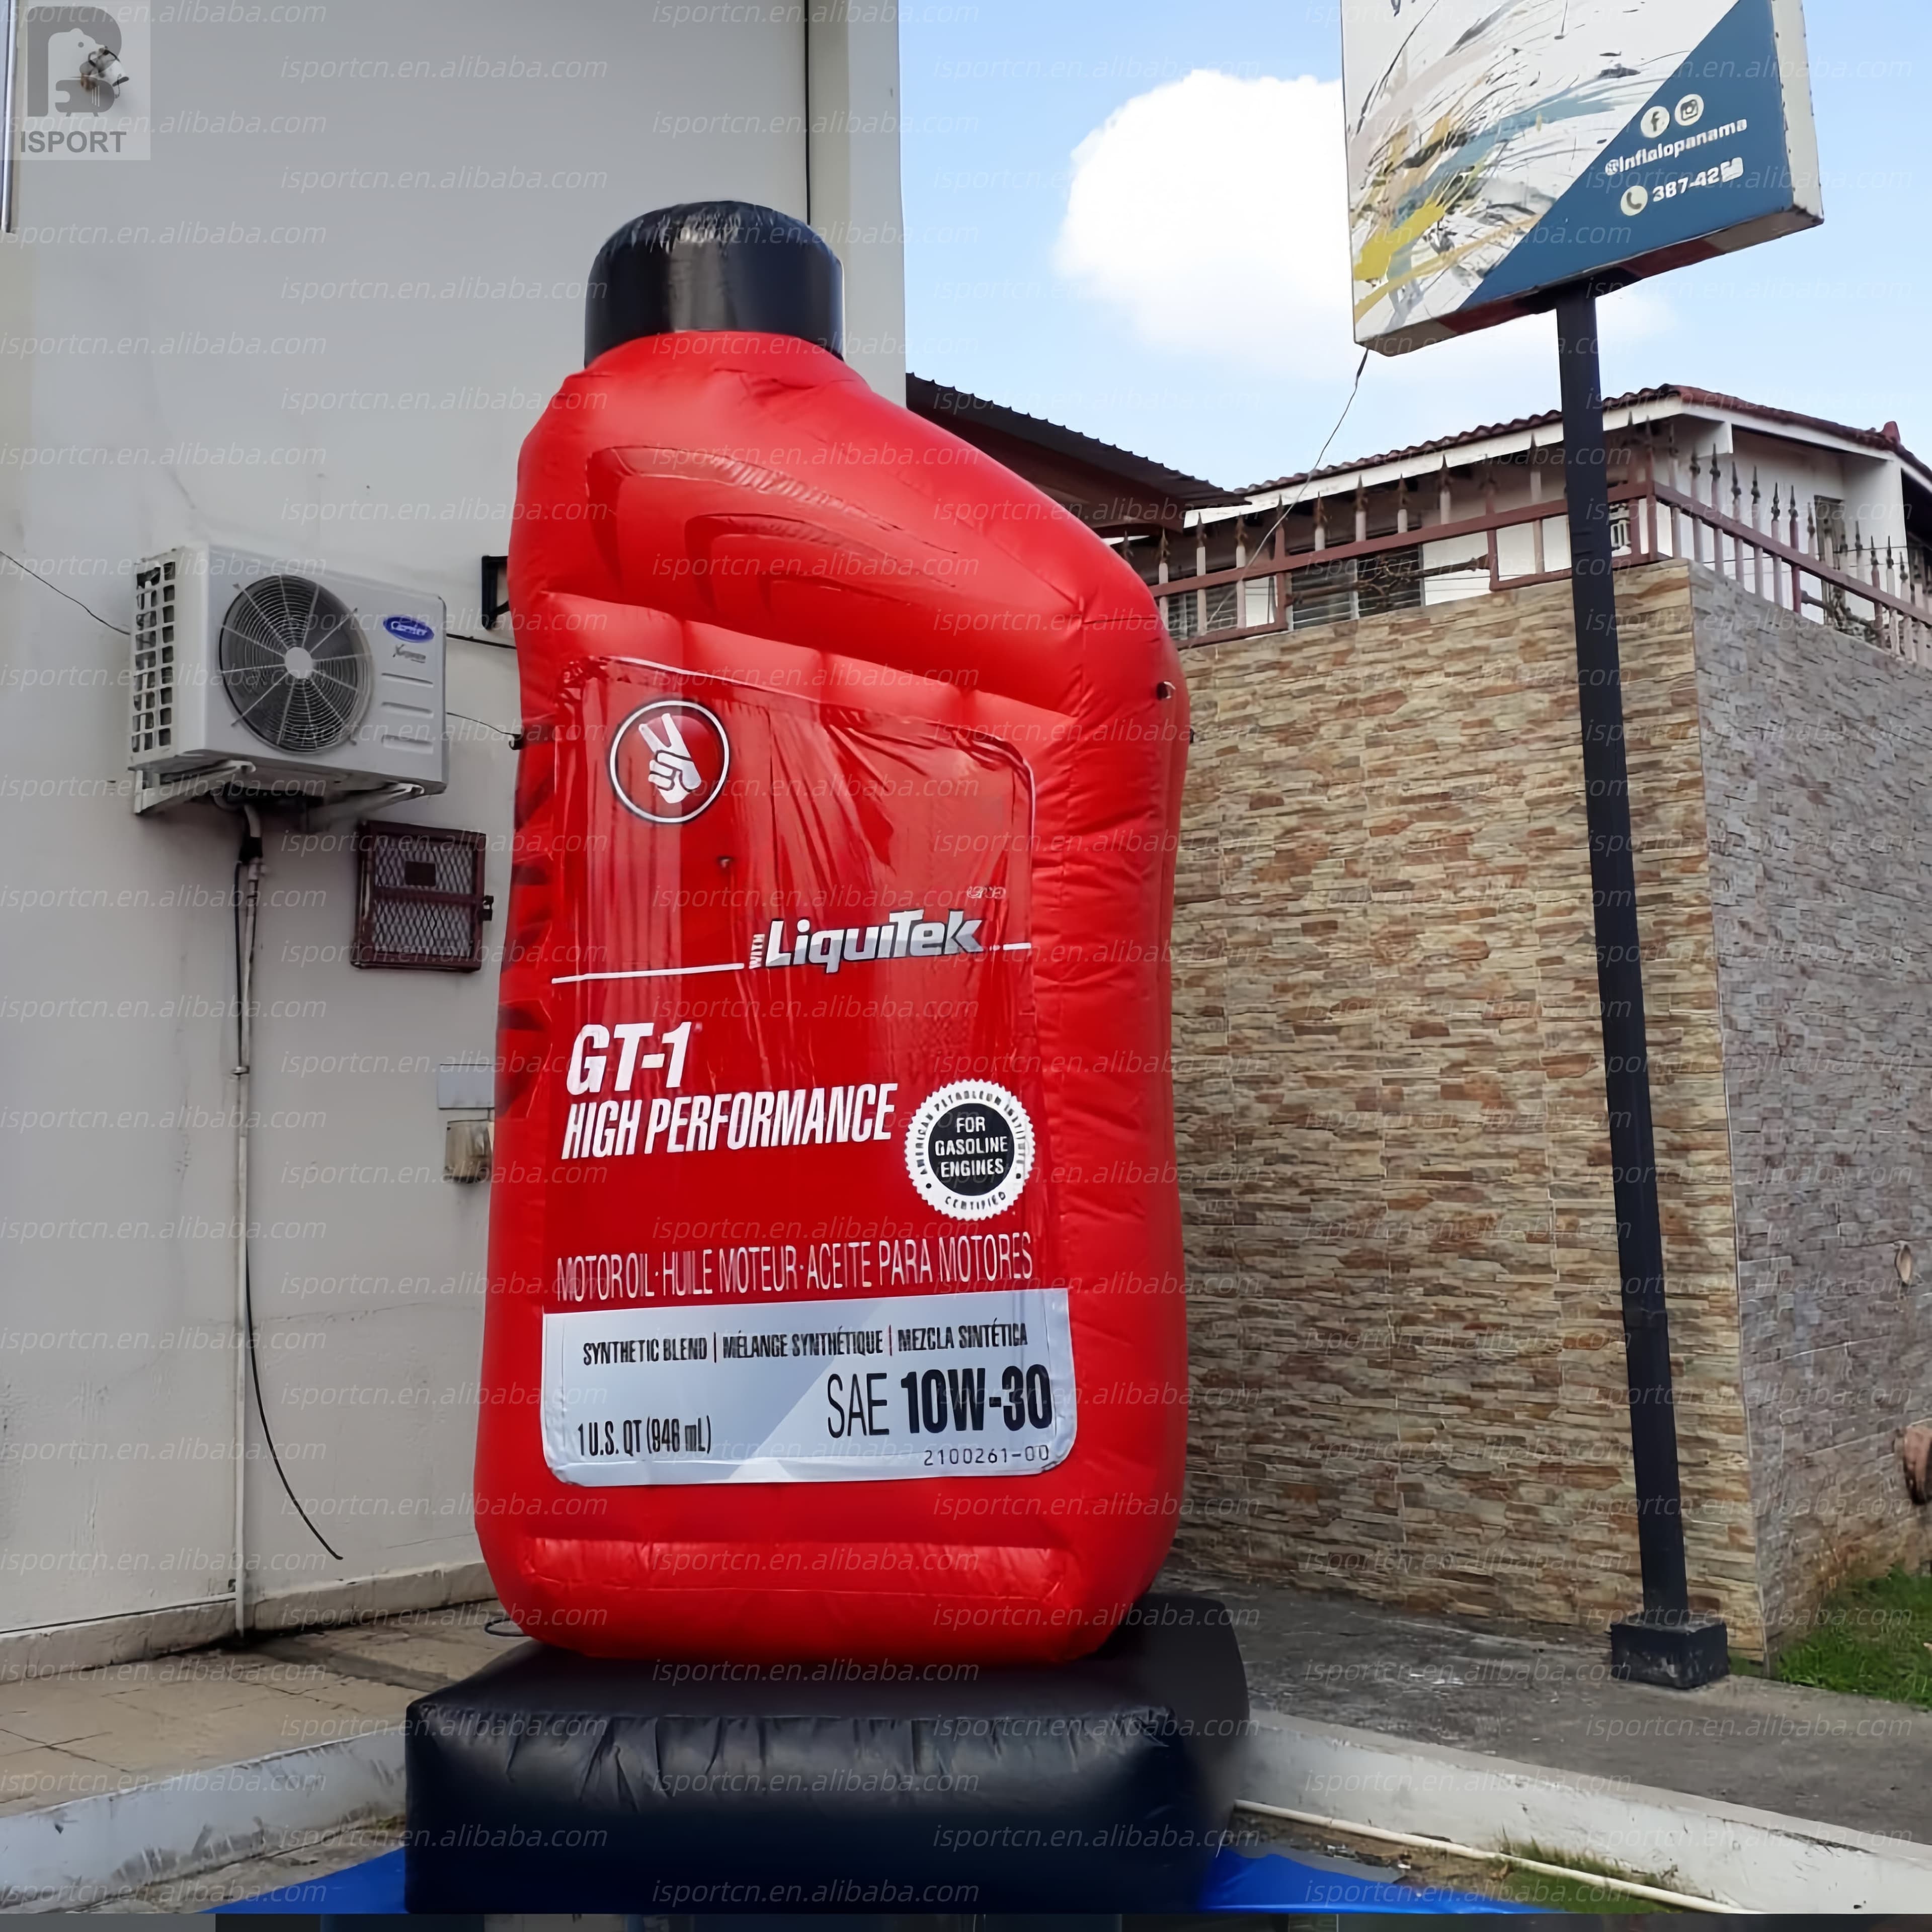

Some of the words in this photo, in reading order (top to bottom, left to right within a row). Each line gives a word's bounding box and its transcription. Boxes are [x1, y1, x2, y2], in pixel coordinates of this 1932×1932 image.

[765, 909, 984, 974] LiquiTek
[566, 1021, 692, 1095] GT-1
[561, 1100, 642, 1159] HIGH
[644, 1083, 898, 1154] PERFORMANCE
[956, 1116, 986, 1133] FOR
[935, 1136, 1008, 1156] GASOLINE
[941, 1158, 1004, 1177] ENGINES
[878, 1238, 933, 1286] PARA
[939, 1232, 1033, 1282] MOTORES
[583, 1338, 659, 1365] SYNTHETIC
[663, 1337, 707, 1361] BLEND
[722, 1330, 788, 1359] MÉLANGE
[791, 1325, 883, 1357] SYNTHÉTIQUE
[898, 1326, 954, 1352] MEZCLA
[827, 1373, 890, 1438] SAE
[900, 1364, 1053, 1434] 10W-30
[578, 1423, 585, 1456] 1
[589, 1420, 619, 1456] U.S.
[623, 1419, 642, 1457] QT
[646, 1415, 680, 1454] (946
[684, 1414, 711, 1454] mL)
[923, 1444, 1050, 1466] 2100261-00
